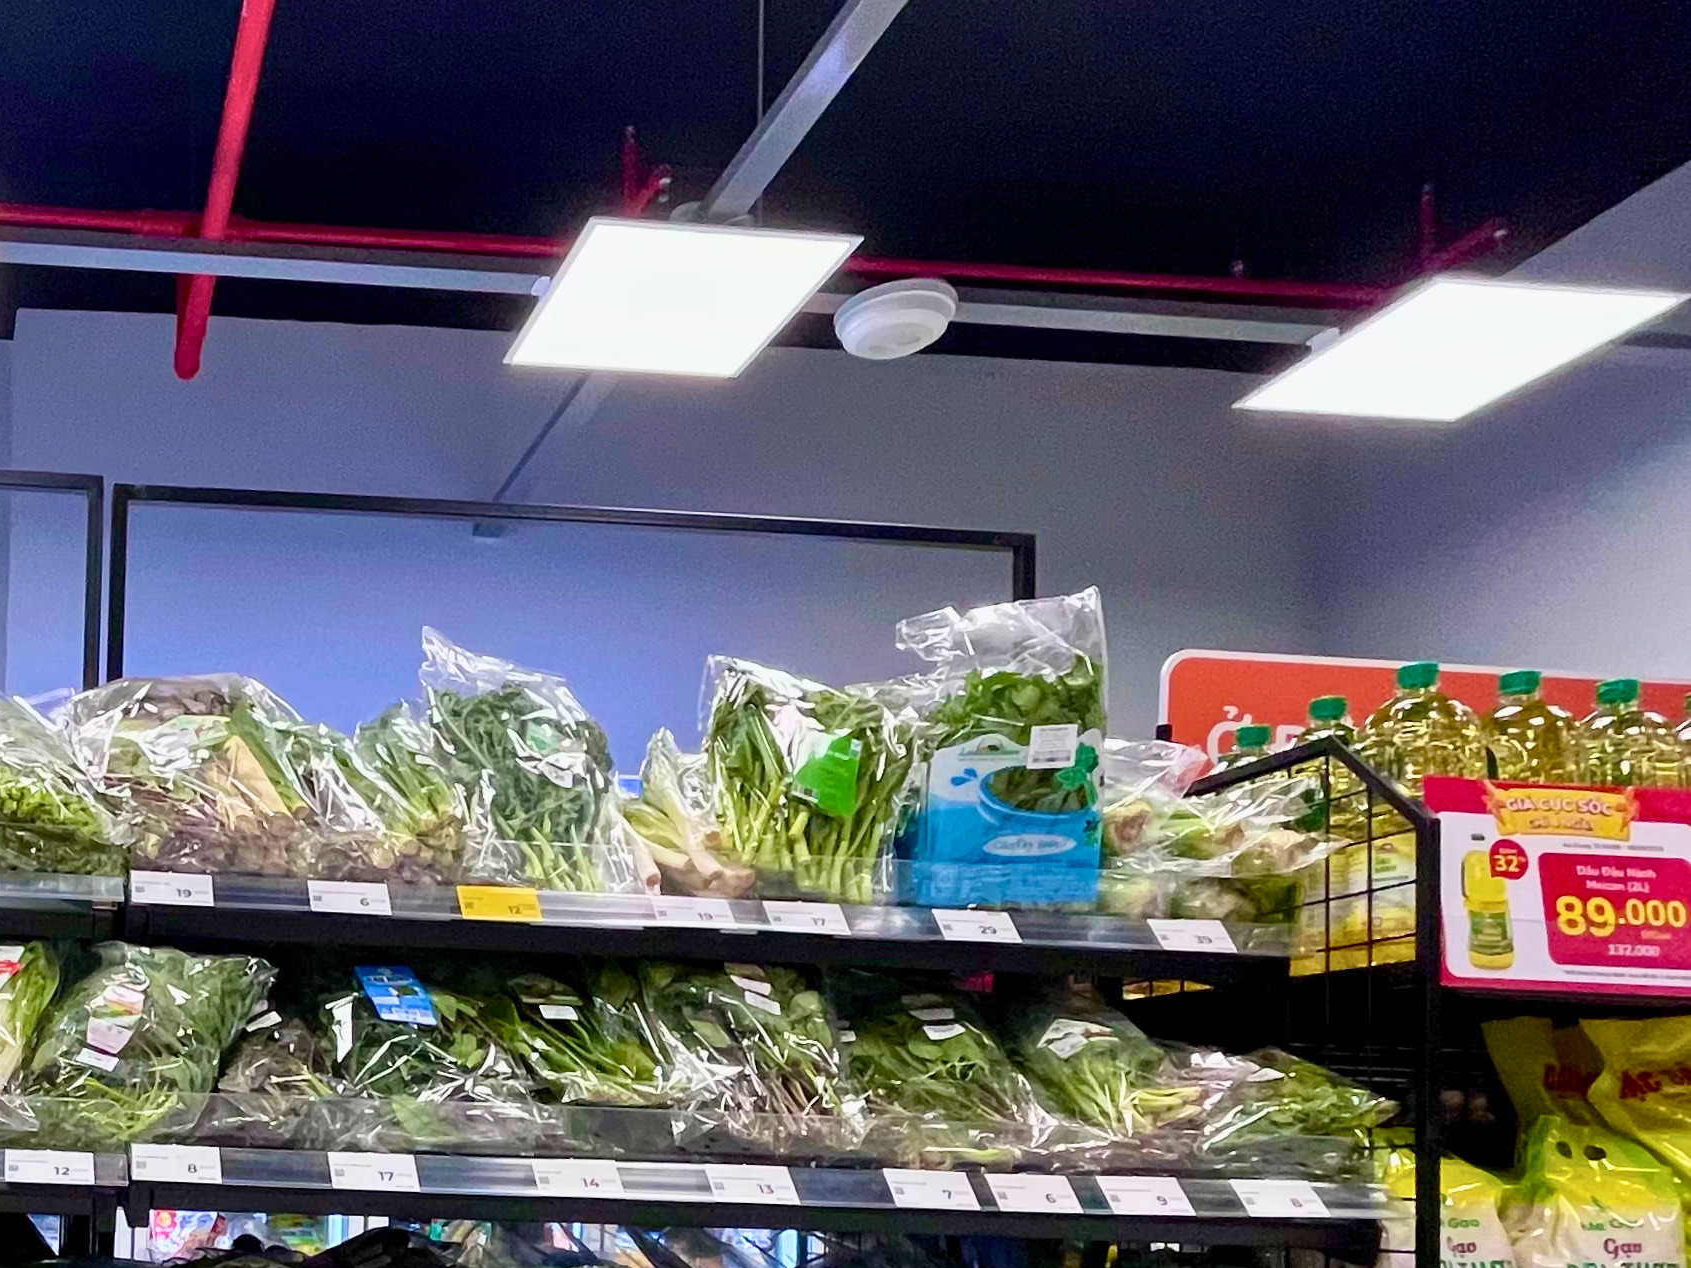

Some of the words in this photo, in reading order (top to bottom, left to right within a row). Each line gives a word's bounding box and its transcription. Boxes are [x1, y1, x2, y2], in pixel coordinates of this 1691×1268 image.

[176, 888, 193, 899] 19
[360, 898, 371, 908] 6
[508, 905, 522, 915] 12
[1555, 895, 1687, 937] 89.000
[53, 1166, 70, 1176] 12
[188, 1163, 198, 1174] 8
[378, 1171, 394, 1182] 17
[582, 1177, 600, 1188] 14
[755, 1183, 775, 1195] 13
[942, 1189, 952, 1200] 7
[1045, 1193, 1056, 1204] 6
[1156, 1195, 1167, 1206] 9
